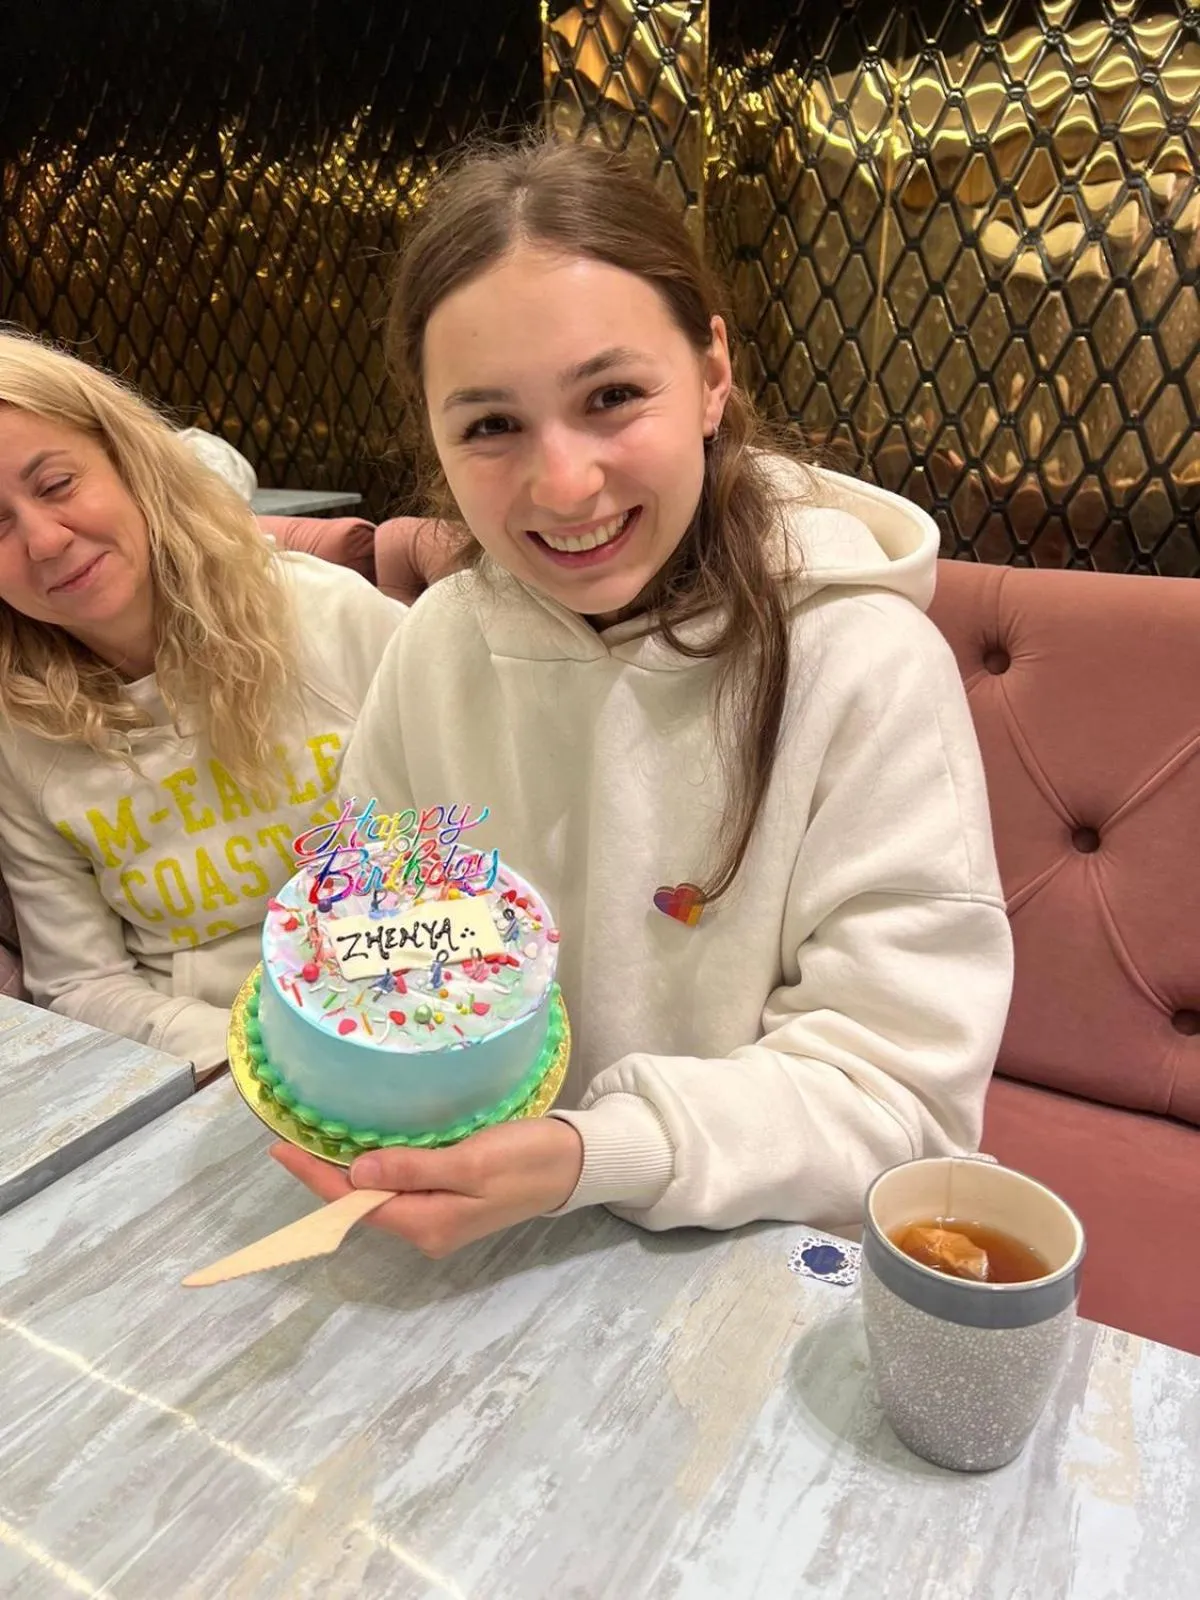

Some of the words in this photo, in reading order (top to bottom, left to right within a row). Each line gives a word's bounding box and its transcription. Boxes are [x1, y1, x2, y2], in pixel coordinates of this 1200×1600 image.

[292, 797, 491, 857] Happy
[294, 845, 499, 904] Birthday
[336, 917, 460, 962] ZHENYA
